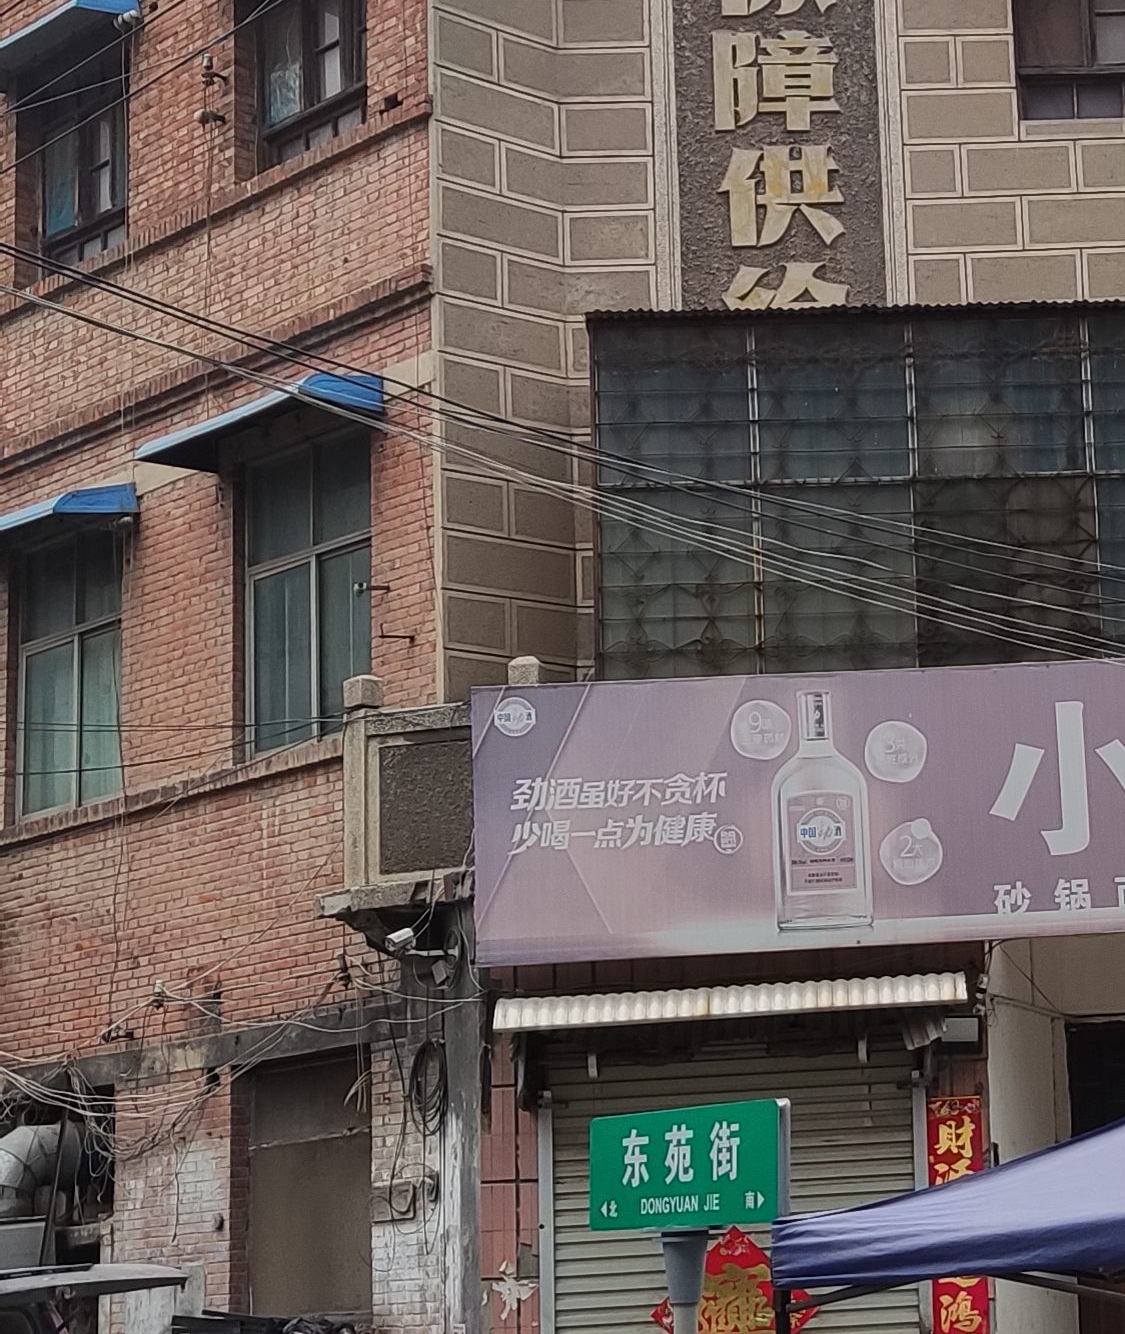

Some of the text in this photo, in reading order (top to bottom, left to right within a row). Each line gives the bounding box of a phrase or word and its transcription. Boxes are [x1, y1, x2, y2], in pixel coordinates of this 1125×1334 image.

[510, 772, 728, 811] 劲酒虽好不贪杯
[507, 812, 718, 855] 少喝一点为健康
[621, 1120, 741, 1188] 东苑街
[640, 1193, 720, 1215] DONGYUAN JIE
[744, 1190, 756, 1210] 南
